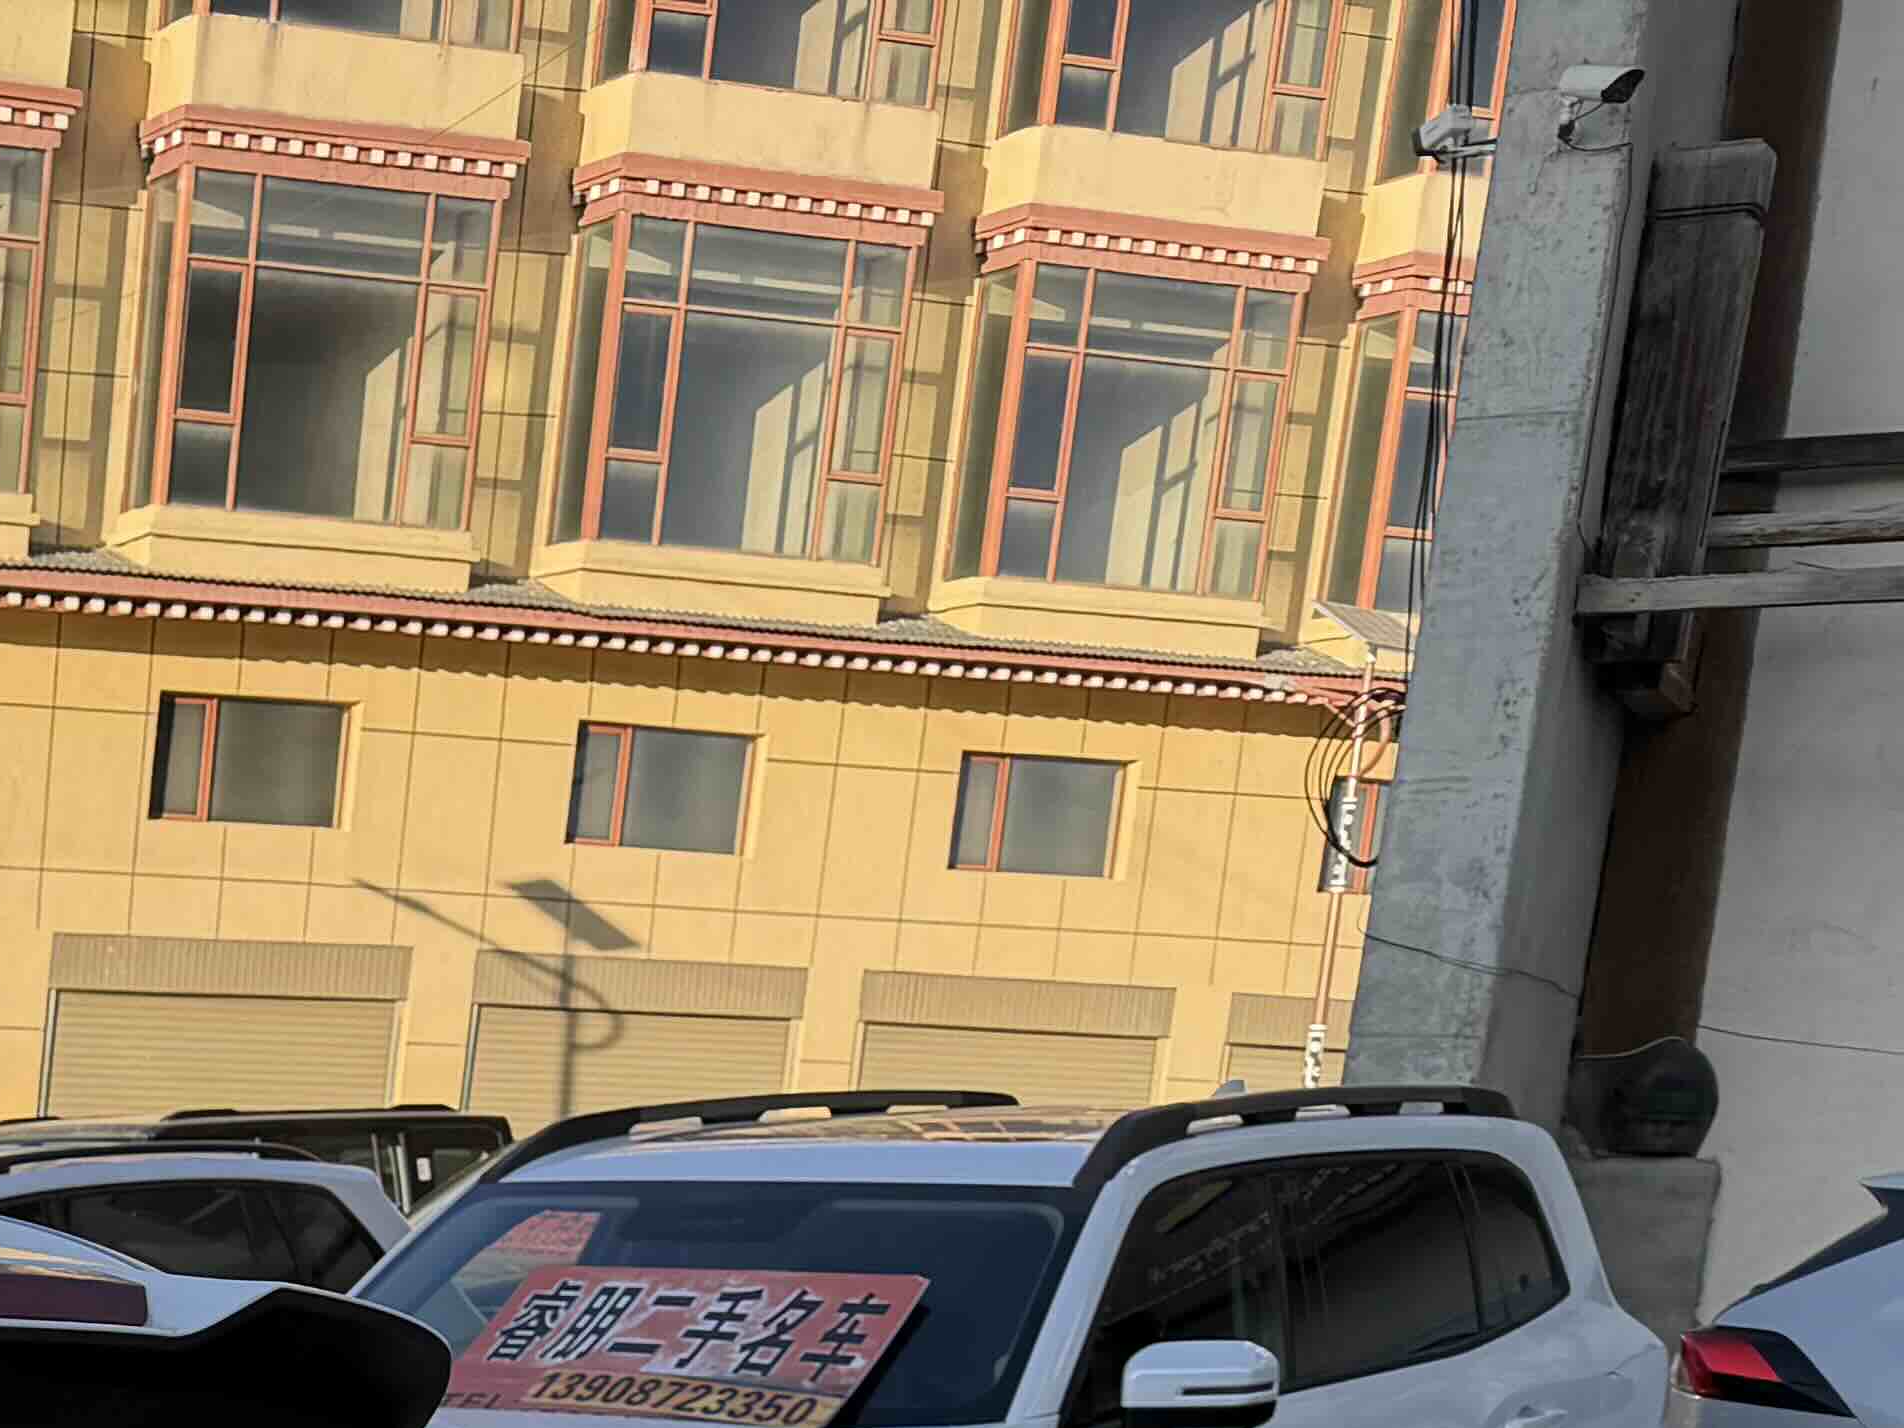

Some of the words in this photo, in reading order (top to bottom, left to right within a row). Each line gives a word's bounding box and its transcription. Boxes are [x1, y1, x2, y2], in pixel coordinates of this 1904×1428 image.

[487, 1279, 892, 1384] 睿朋二手名车
[531, 1371, 818, 1425] 13908723350
